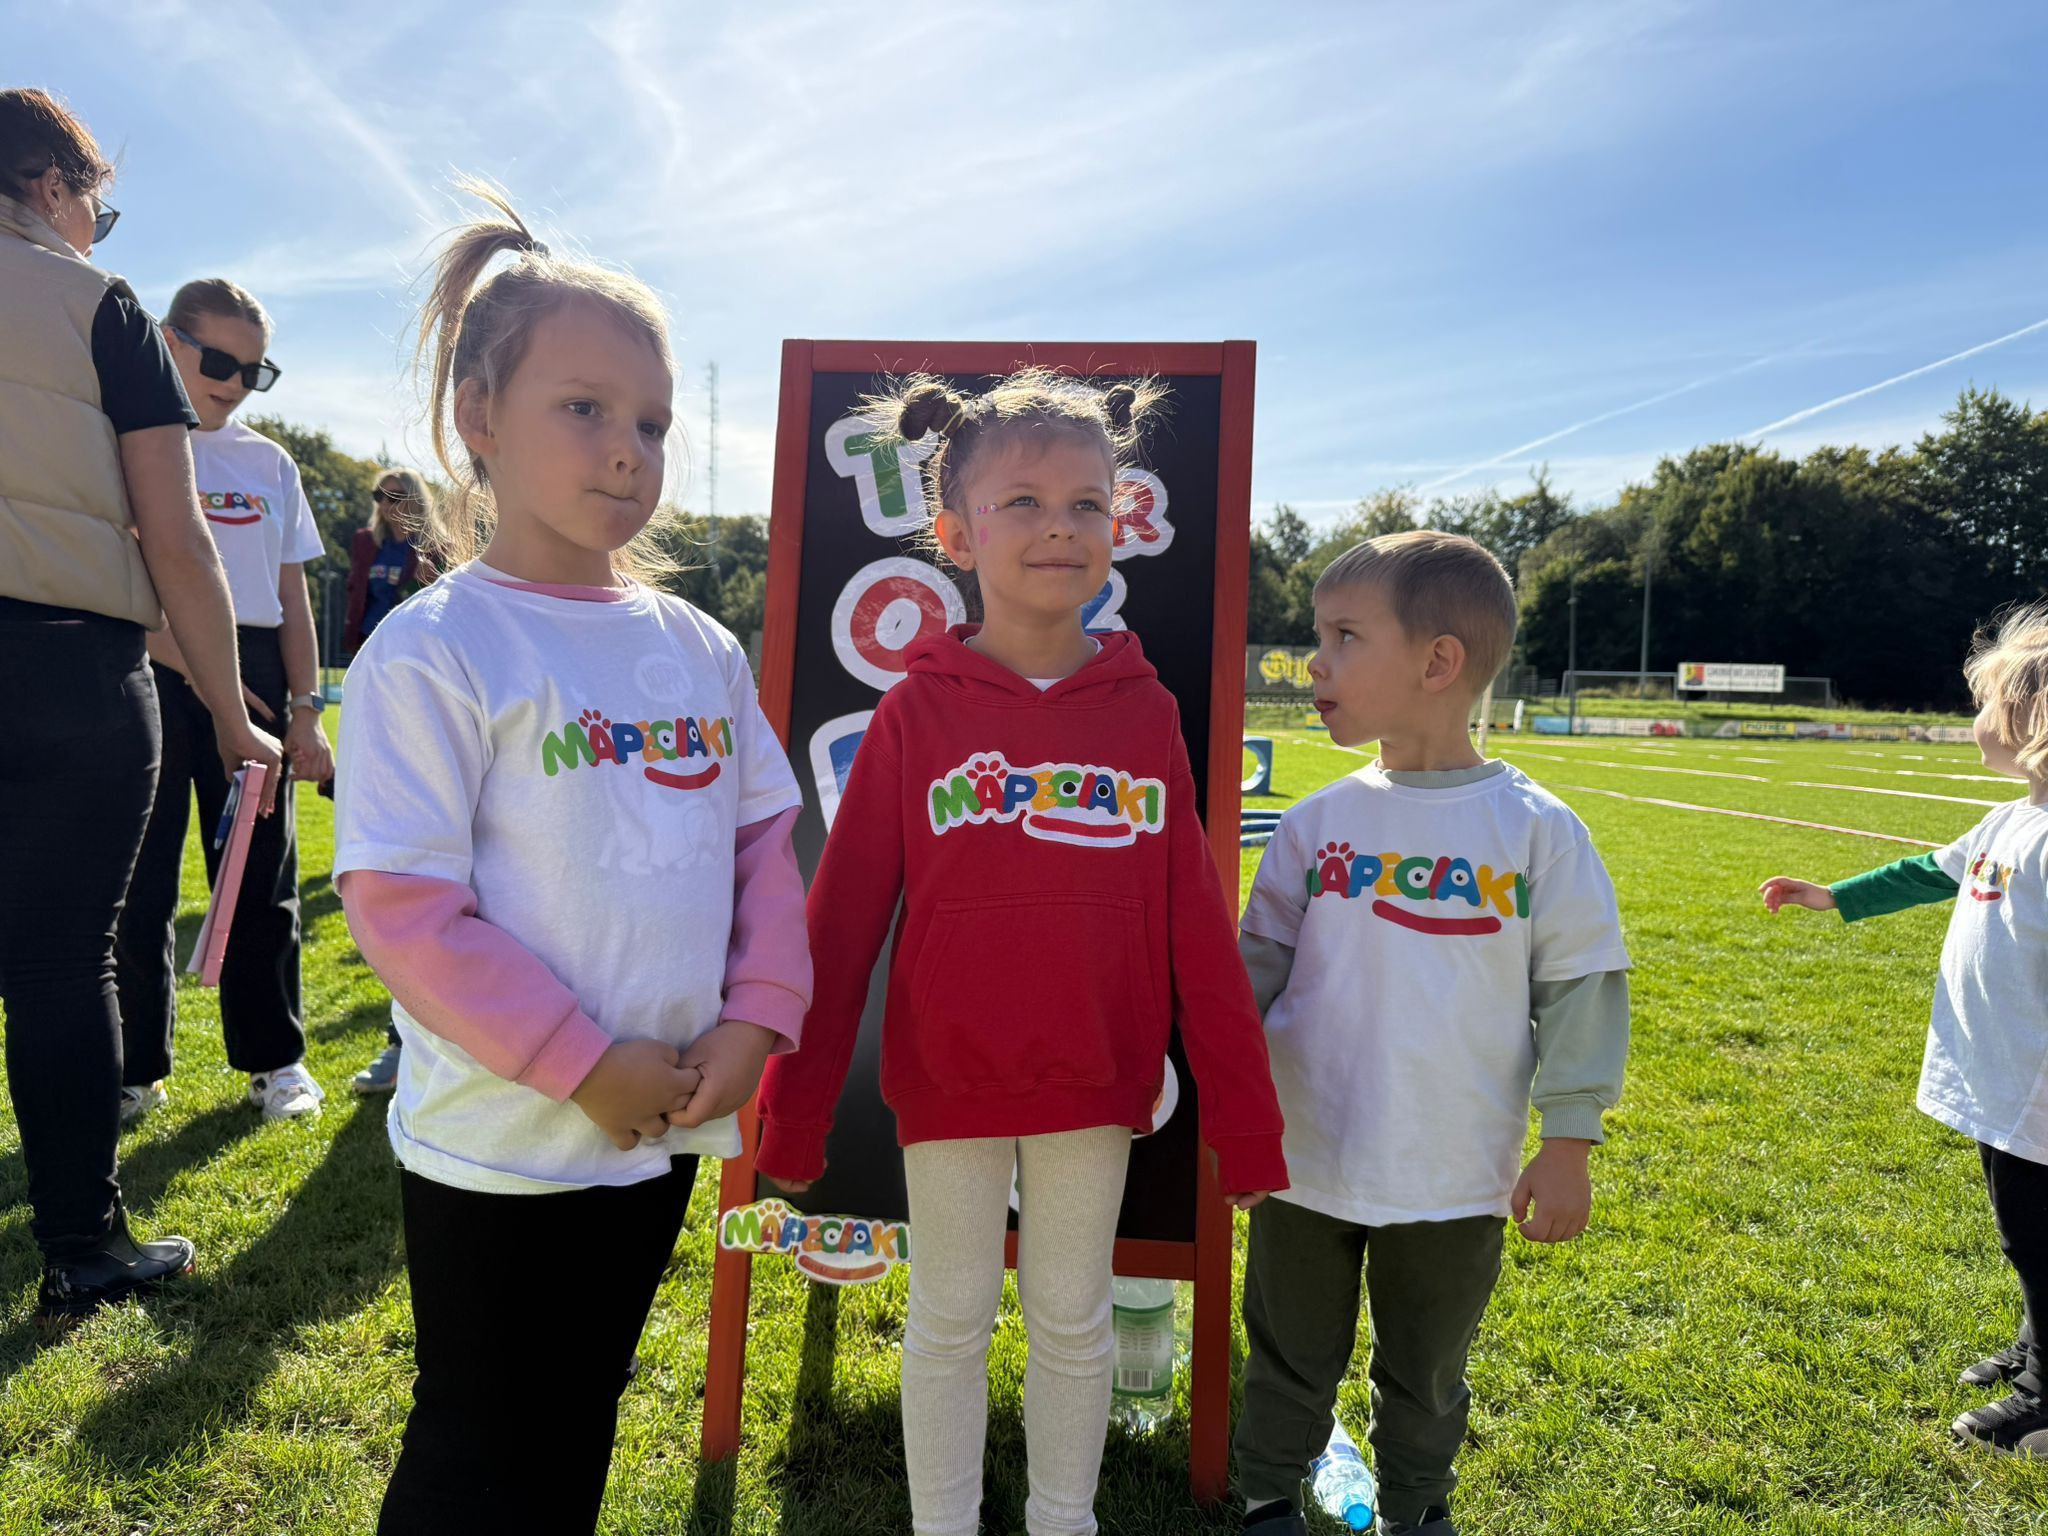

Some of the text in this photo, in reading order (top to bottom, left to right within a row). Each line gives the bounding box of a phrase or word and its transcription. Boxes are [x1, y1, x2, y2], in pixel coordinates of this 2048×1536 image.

[542, 716, 733, 777] MAPECIAKI
[932, 769, 1159, 826] MAPECIAKI
[725, 1211, 909, 1260] MAPECIAKI
